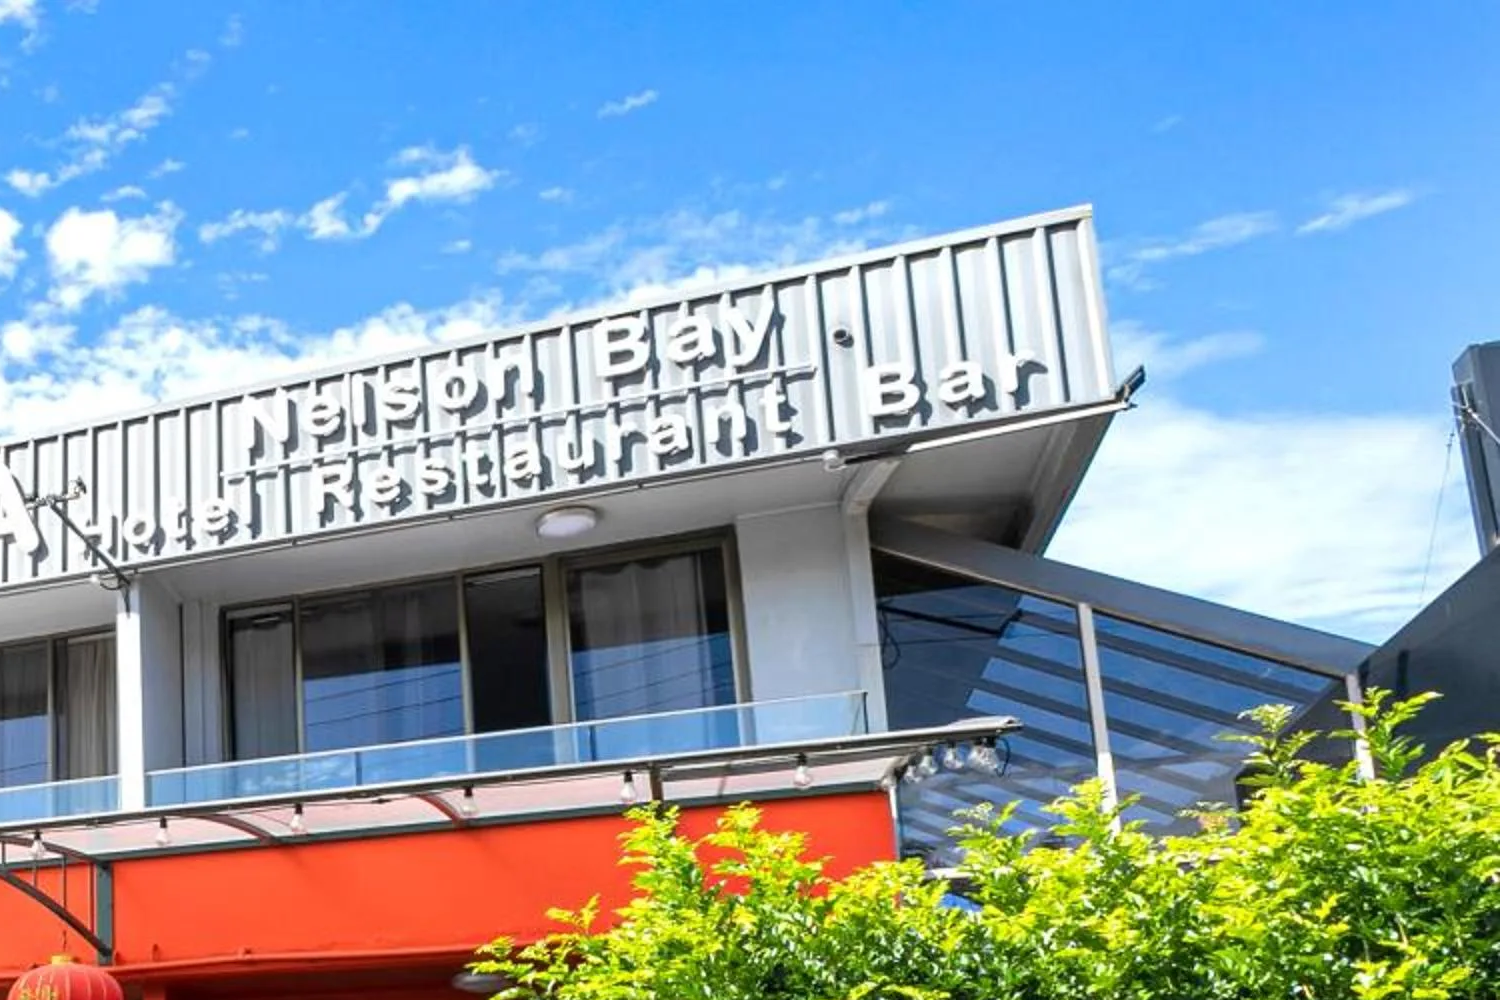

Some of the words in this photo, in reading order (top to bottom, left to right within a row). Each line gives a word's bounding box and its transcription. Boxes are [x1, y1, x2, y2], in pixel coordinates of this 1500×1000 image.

[78, 478, 257, 556] Hotel
[316, 386, 792, 513] Restaurant
[866, 350, 1035, 416] Bar
[239, 344, 534, 449] Nelson
[592, 296, 775, 378] Bay
